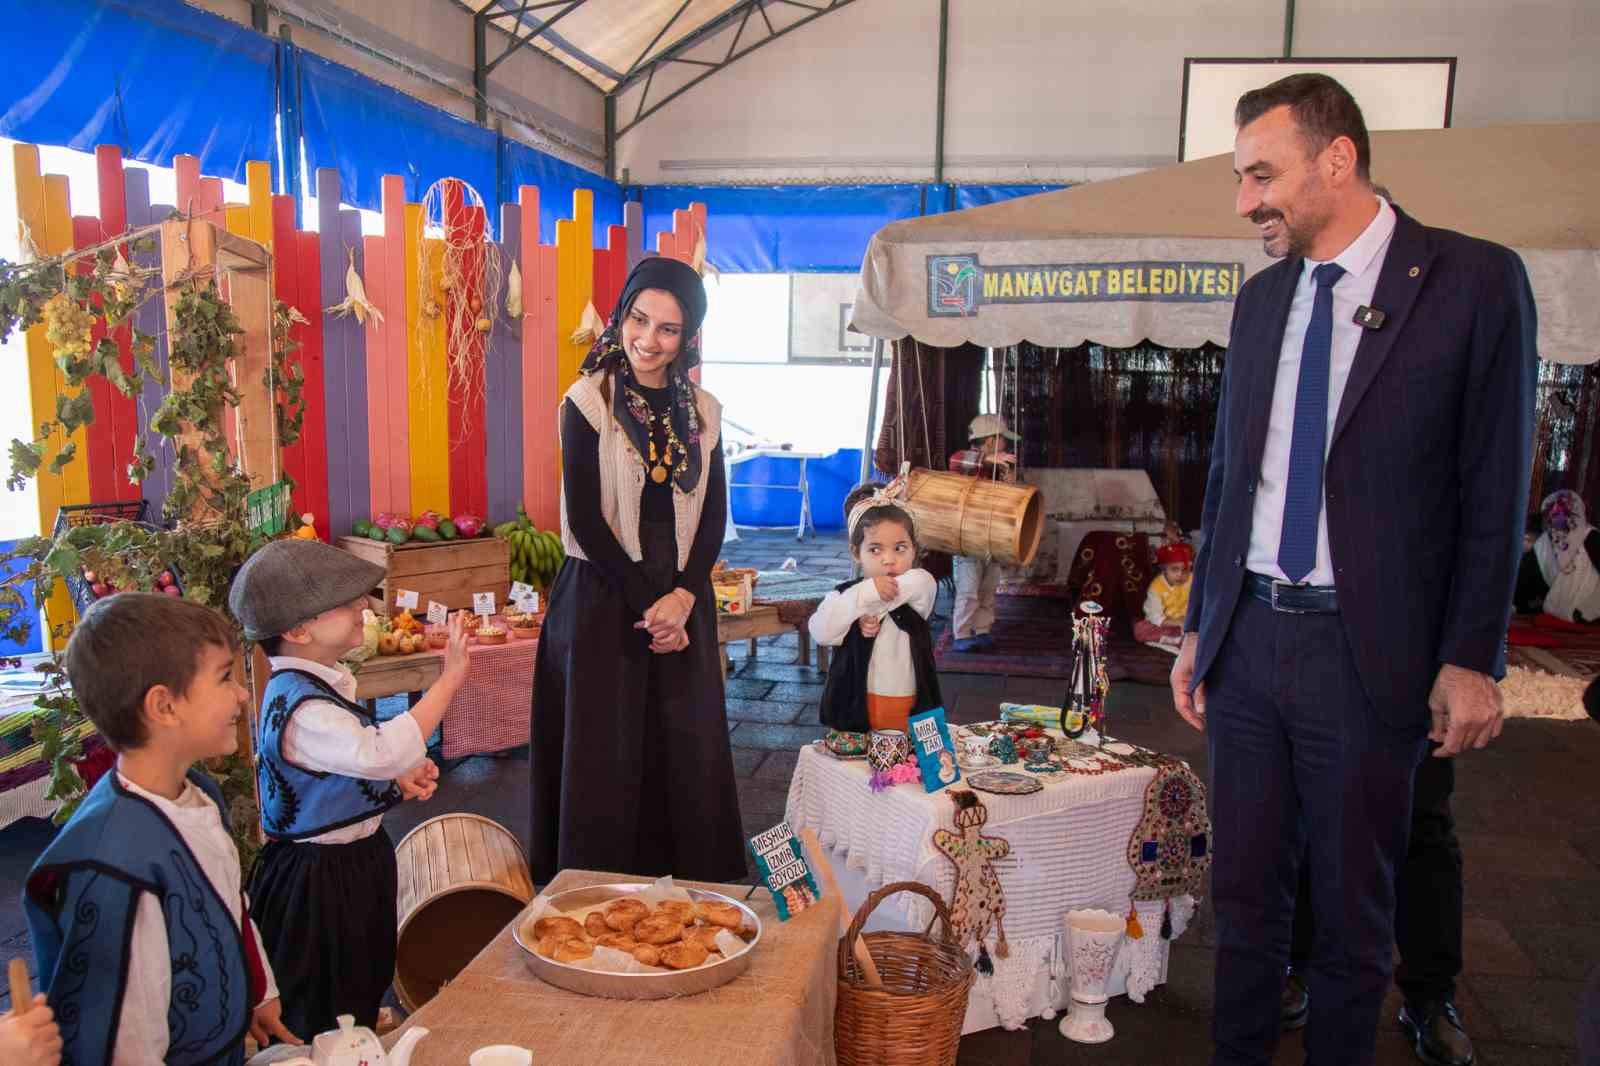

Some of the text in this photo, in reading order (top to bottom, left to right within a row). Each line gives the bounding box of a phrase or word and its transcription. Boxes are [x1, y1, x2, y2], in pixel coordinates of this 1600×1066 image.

[983, 263, 1240, 298] MANAVGAT BELEDİYESİ
[752, 822, 792, 852] MEŞHUR
[767, 847, 794, 870] İZMİR
[768, 862, 806, 889] BOYOZU
